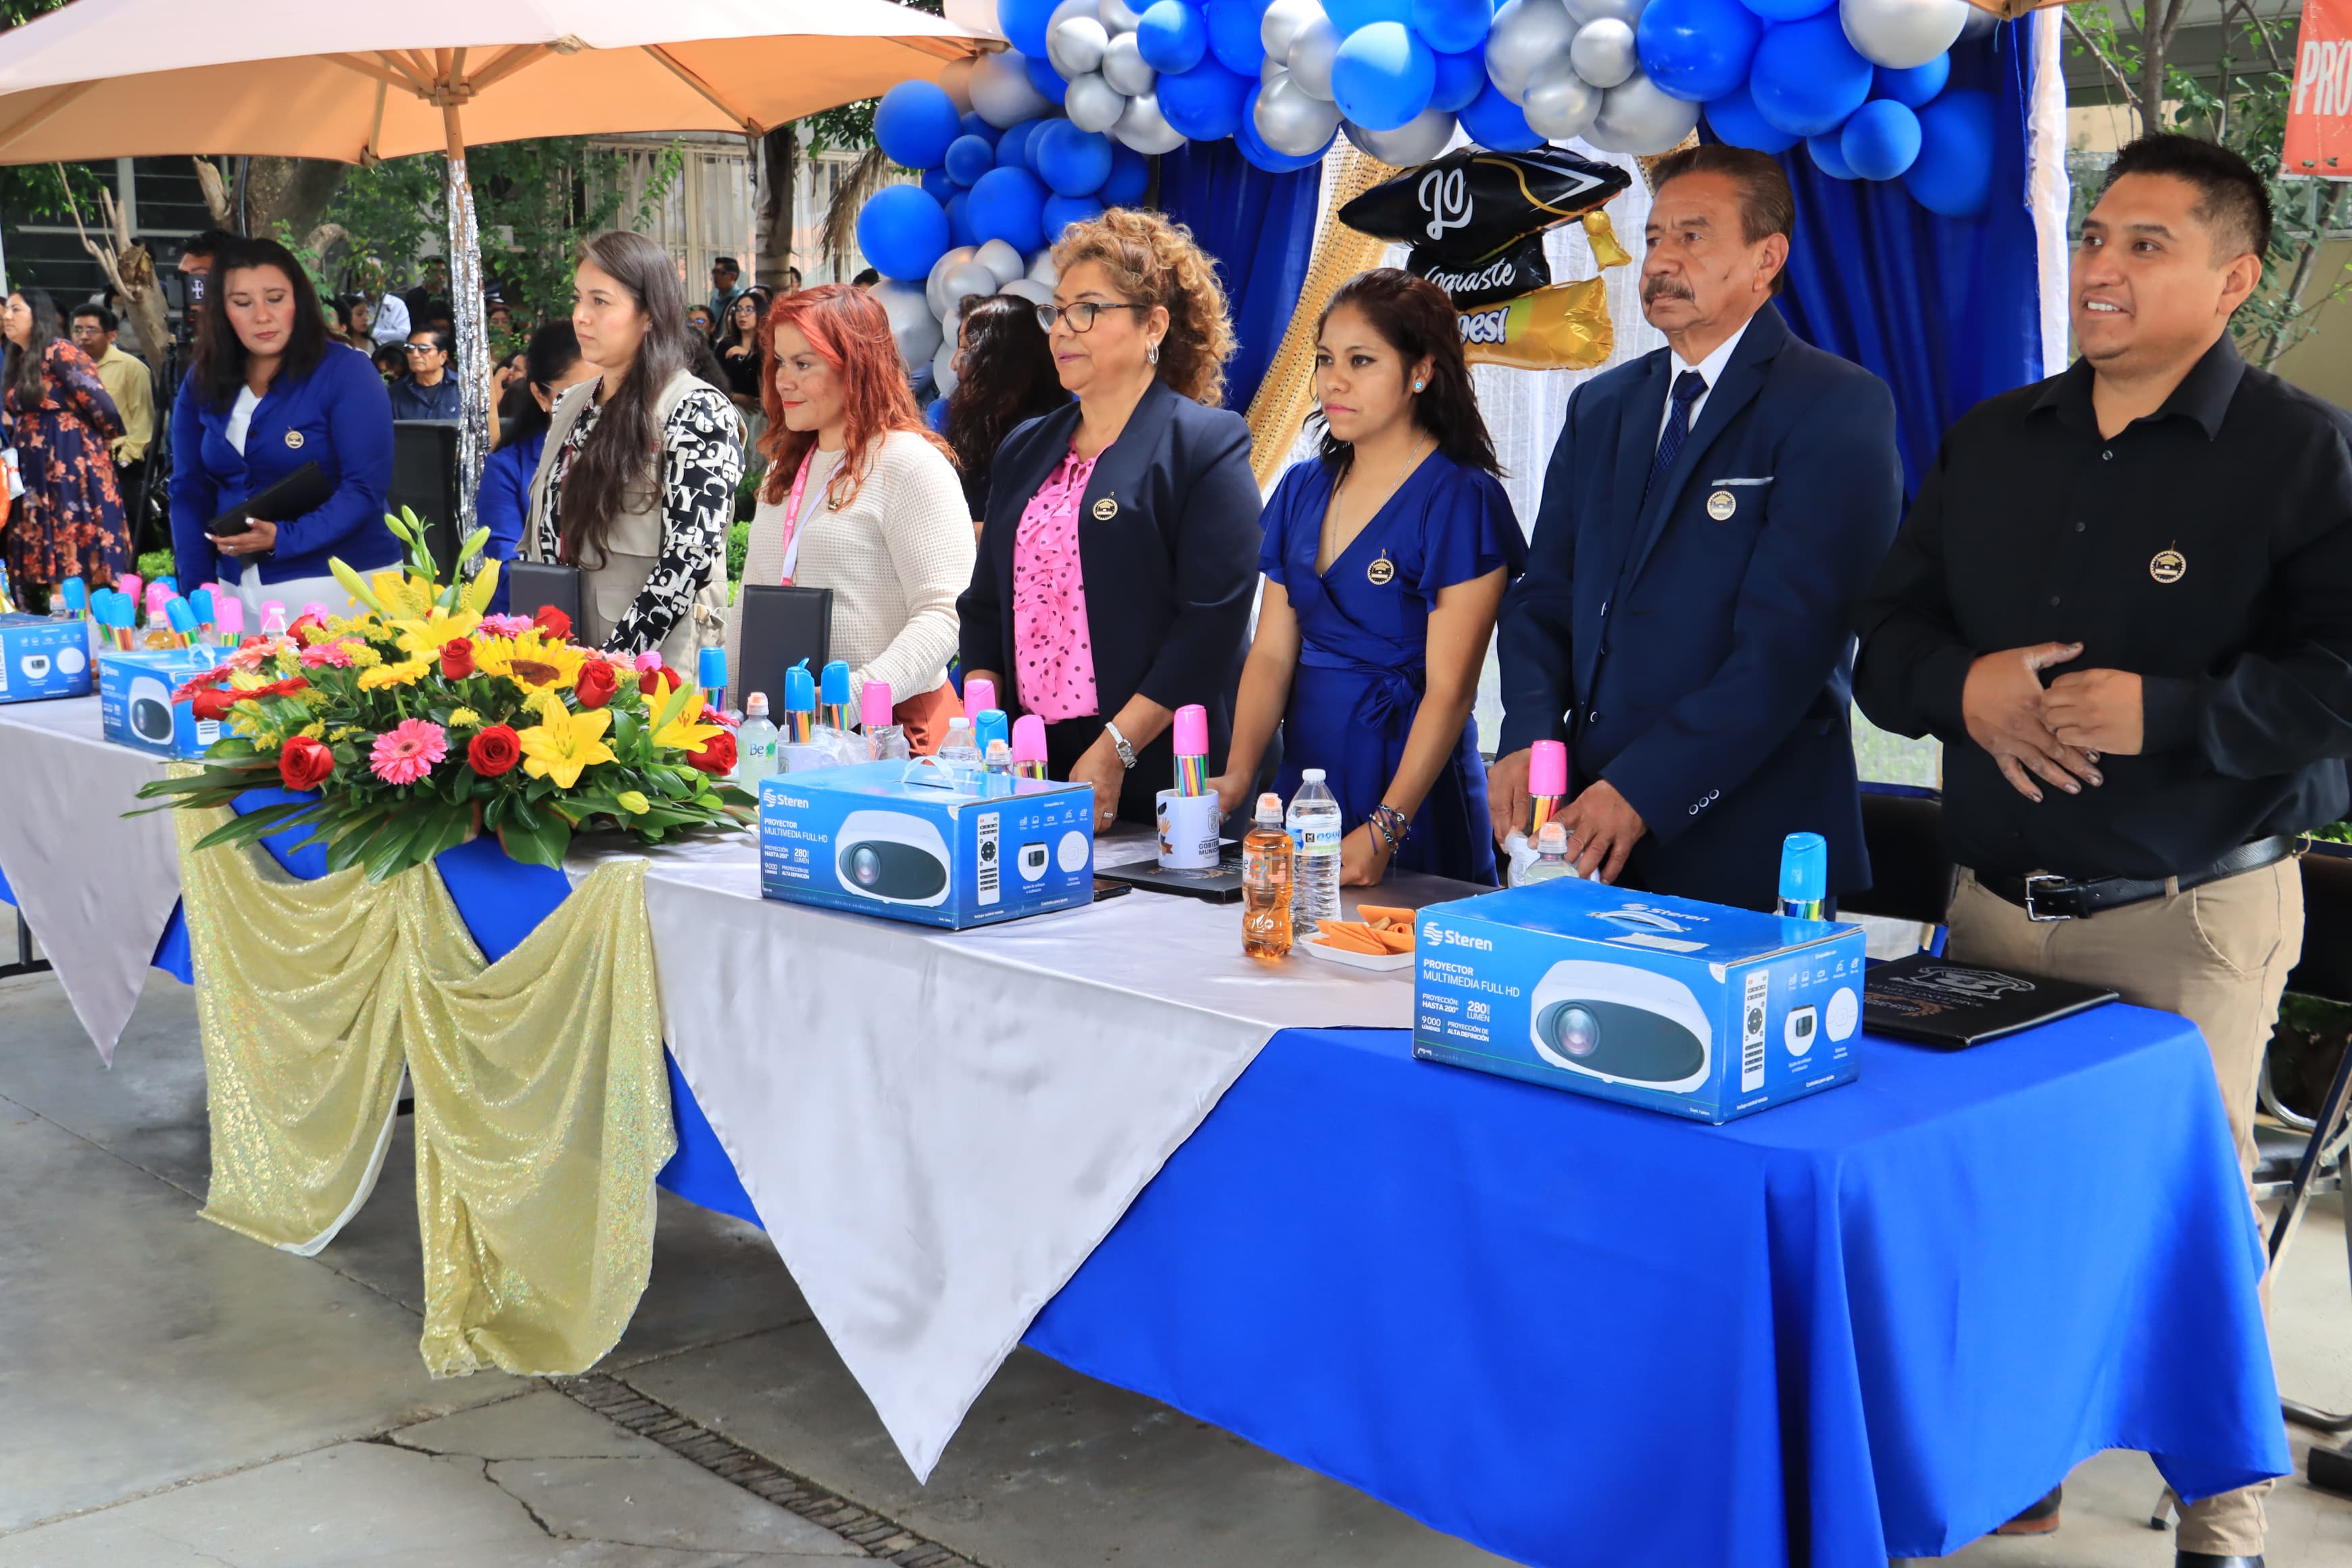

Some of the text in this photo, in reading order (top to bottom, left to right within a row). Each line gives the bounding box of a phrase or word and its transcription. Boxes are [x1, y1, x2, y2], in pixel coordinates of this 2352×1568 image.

[750, 743, 764, 756] Be
[777, 793, 810, 809] Steren
[764, 818, 798, 829] PROYECTOR
[764, 826, 828, 843] MULTIMEDIA FULL HD
[764, 850, 779, 858] HASTA
[794, 848, 807, 858] 280
[1647, 908, 1711, 922] Steren
[1445, 929, 1493, 952] Steren
[1423, 958, 1474, 976] PROYECTOR
[1423, 969, 1520, 998] MULTIMEDIA FULL HD
[1422, 1000, 1444, 1011] HASTA
[1467, 1000, 1487, 1014] 280
[1467, 1010, 1490, 1023] LUMEN
[1447, 1029, 1461, 1037] ALTA
[1448, 1021, 1490, 1035] PROYECCIÓN DE
